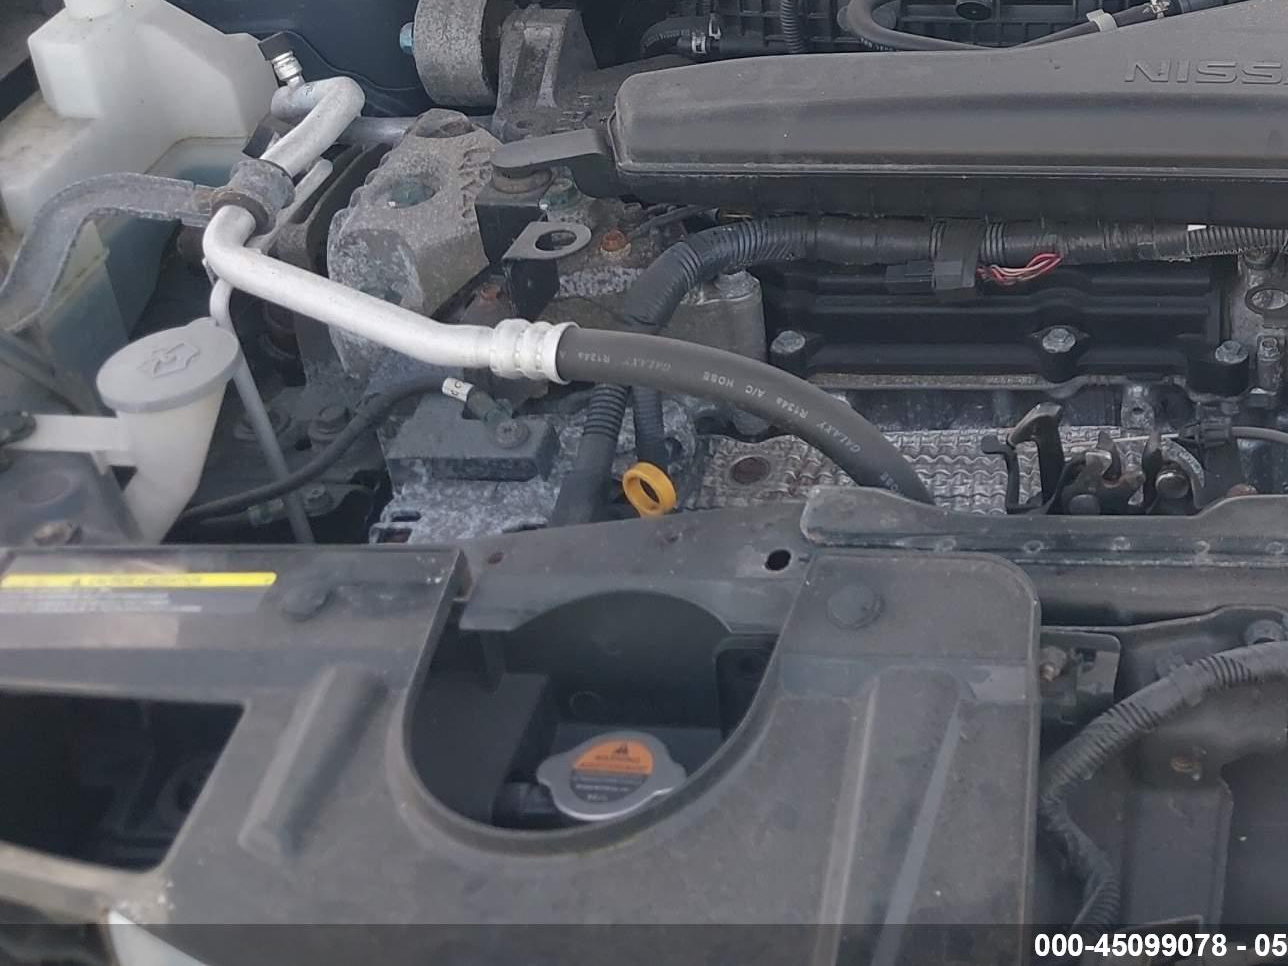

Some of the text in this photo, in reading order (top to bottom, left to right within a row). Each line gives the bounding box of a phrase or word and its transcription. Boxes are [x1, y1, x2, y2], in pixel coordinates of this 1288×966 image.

[702, 371, 735, 387] HOSE
[744, 385, 767, 399] A/C
[816, 420, 862, 453] GALAXY
